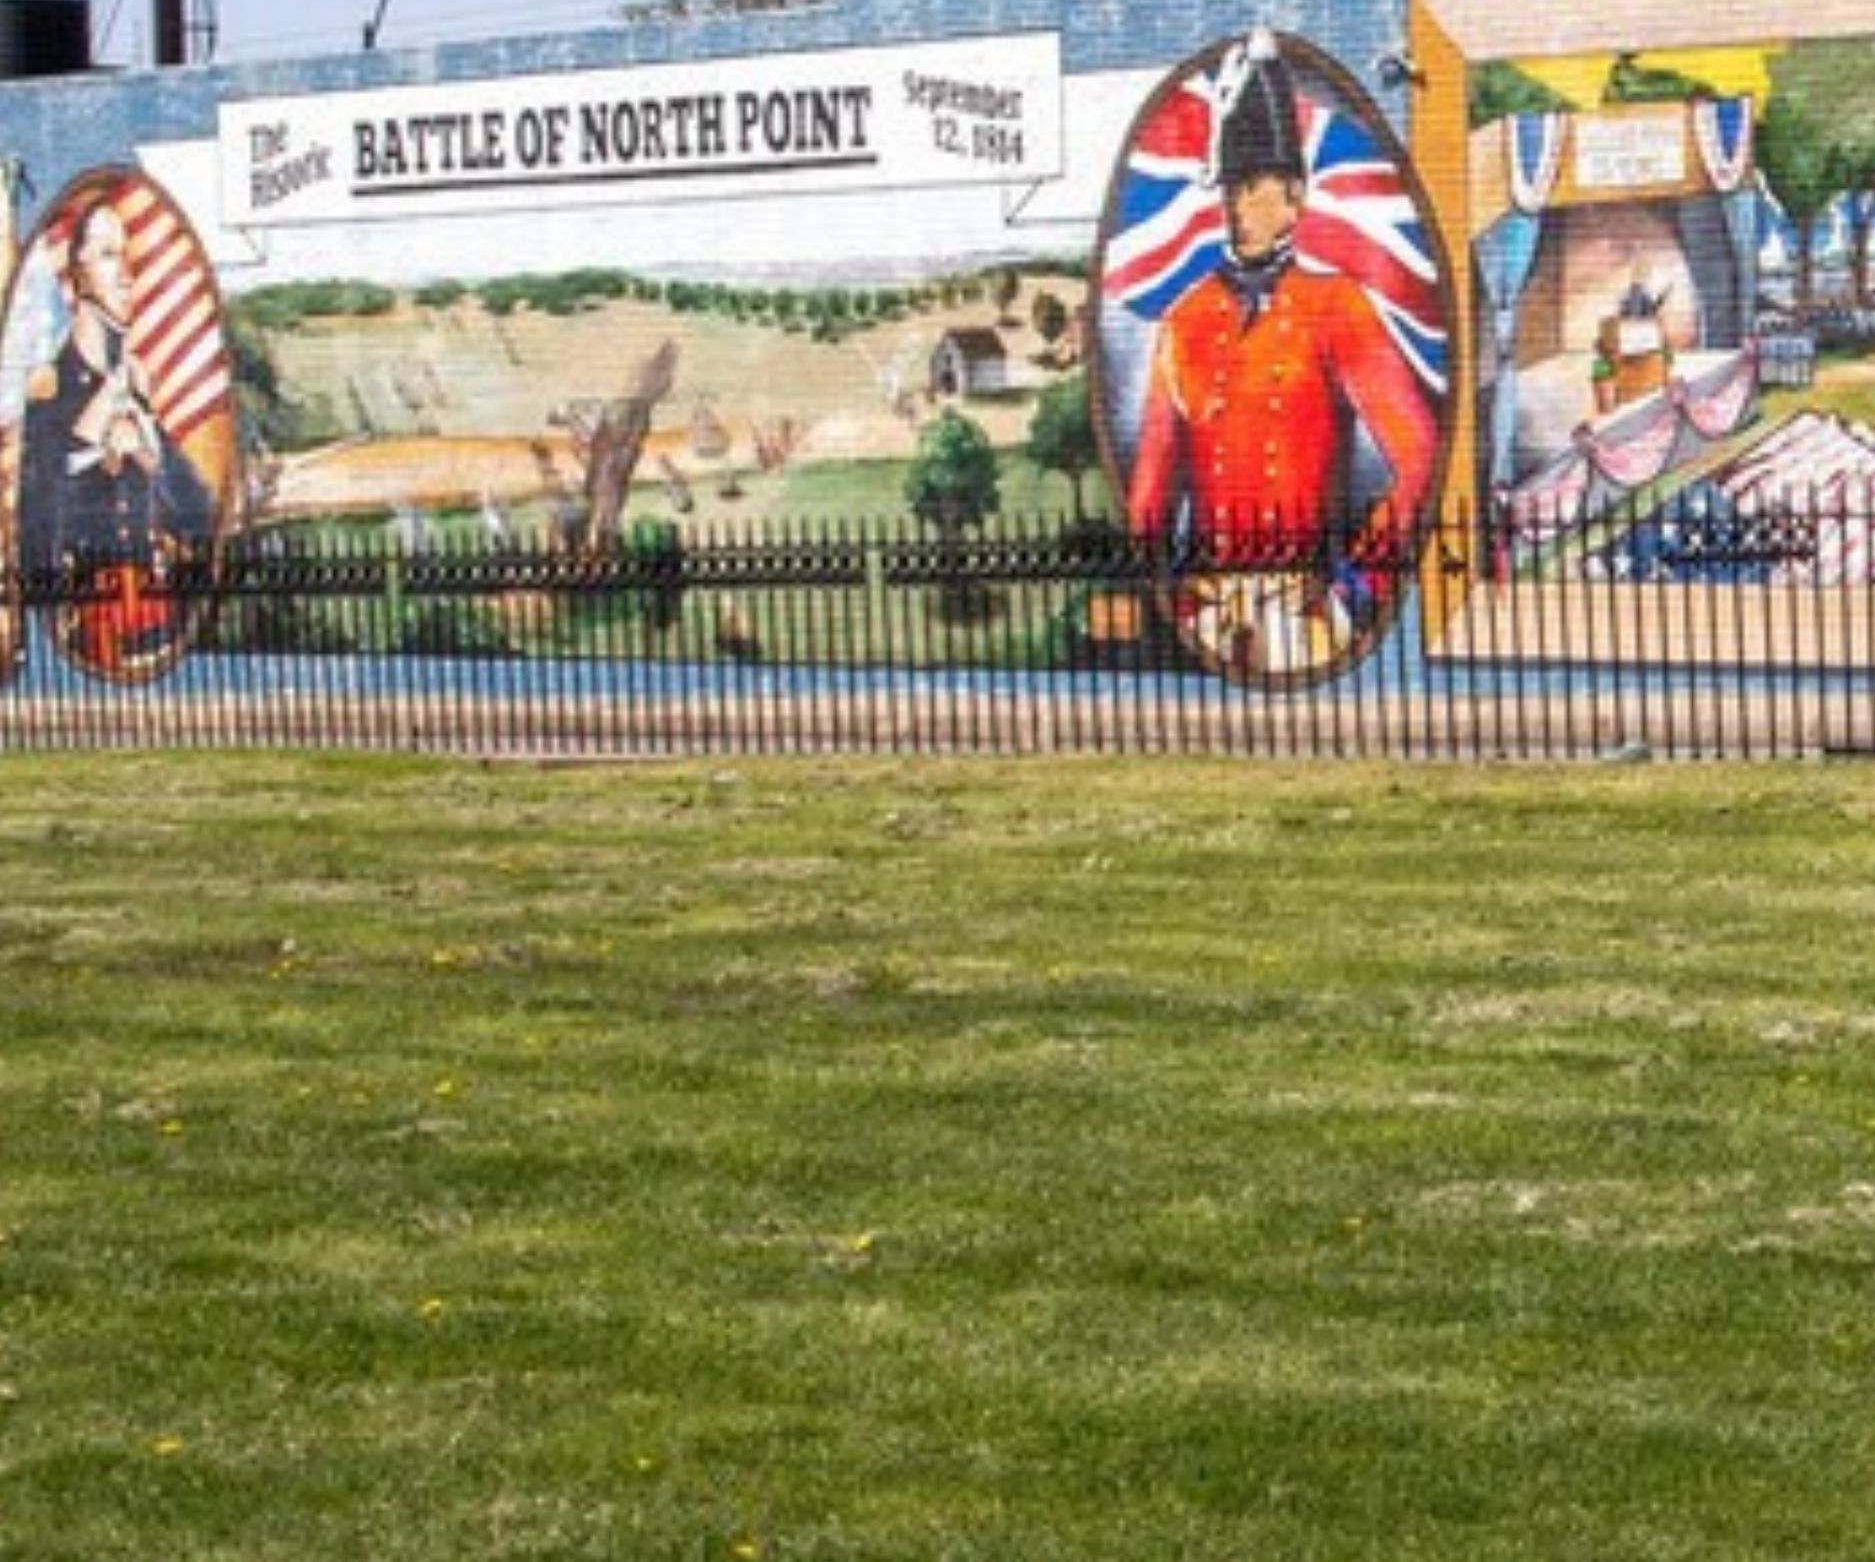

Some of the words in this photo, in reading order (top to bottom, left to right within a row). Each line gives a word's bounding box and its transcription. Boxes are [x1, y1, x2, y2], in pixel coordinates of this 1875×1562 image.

[902, 69, 1023, 120] September
[248, 119, 289, 163] The
[352, 109, 505, 178] BATTLE
[514, 104, 569, 168] OF
[578, 92, 726, 165] NORTH
[736, 85, 872, 153] POINT
